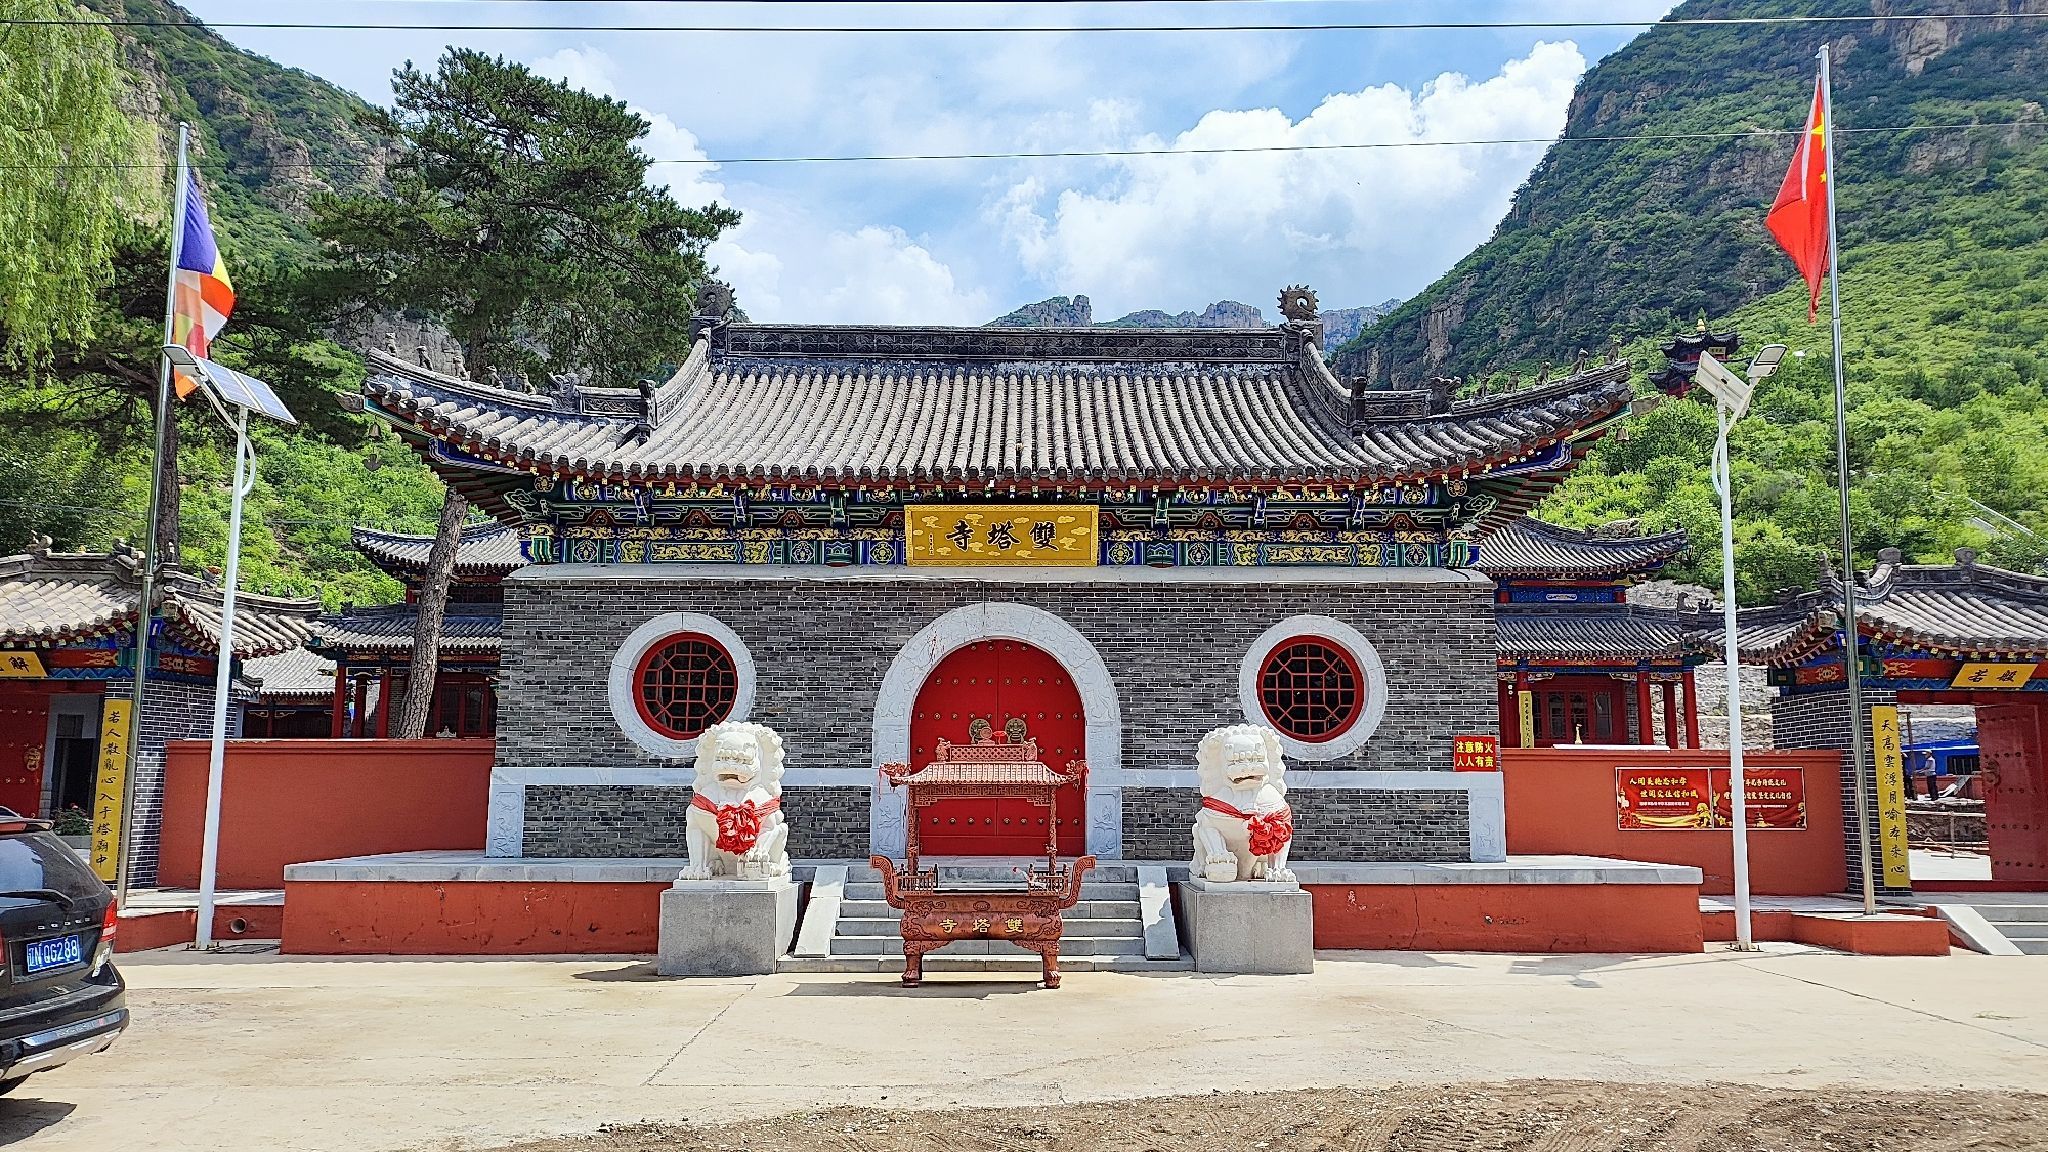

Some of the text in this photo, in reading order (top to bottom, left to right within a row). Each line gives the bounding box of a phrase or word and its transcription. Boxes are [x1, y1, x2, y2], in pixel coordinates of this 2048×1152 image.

[946, 519, 1059, 551] 雙塔寺
[1456, 741, 1494, 753] 注意防火
[1457, 756, 1494, 767] 人人有责
[939, 918, 1024, 934] 雙塔寺
